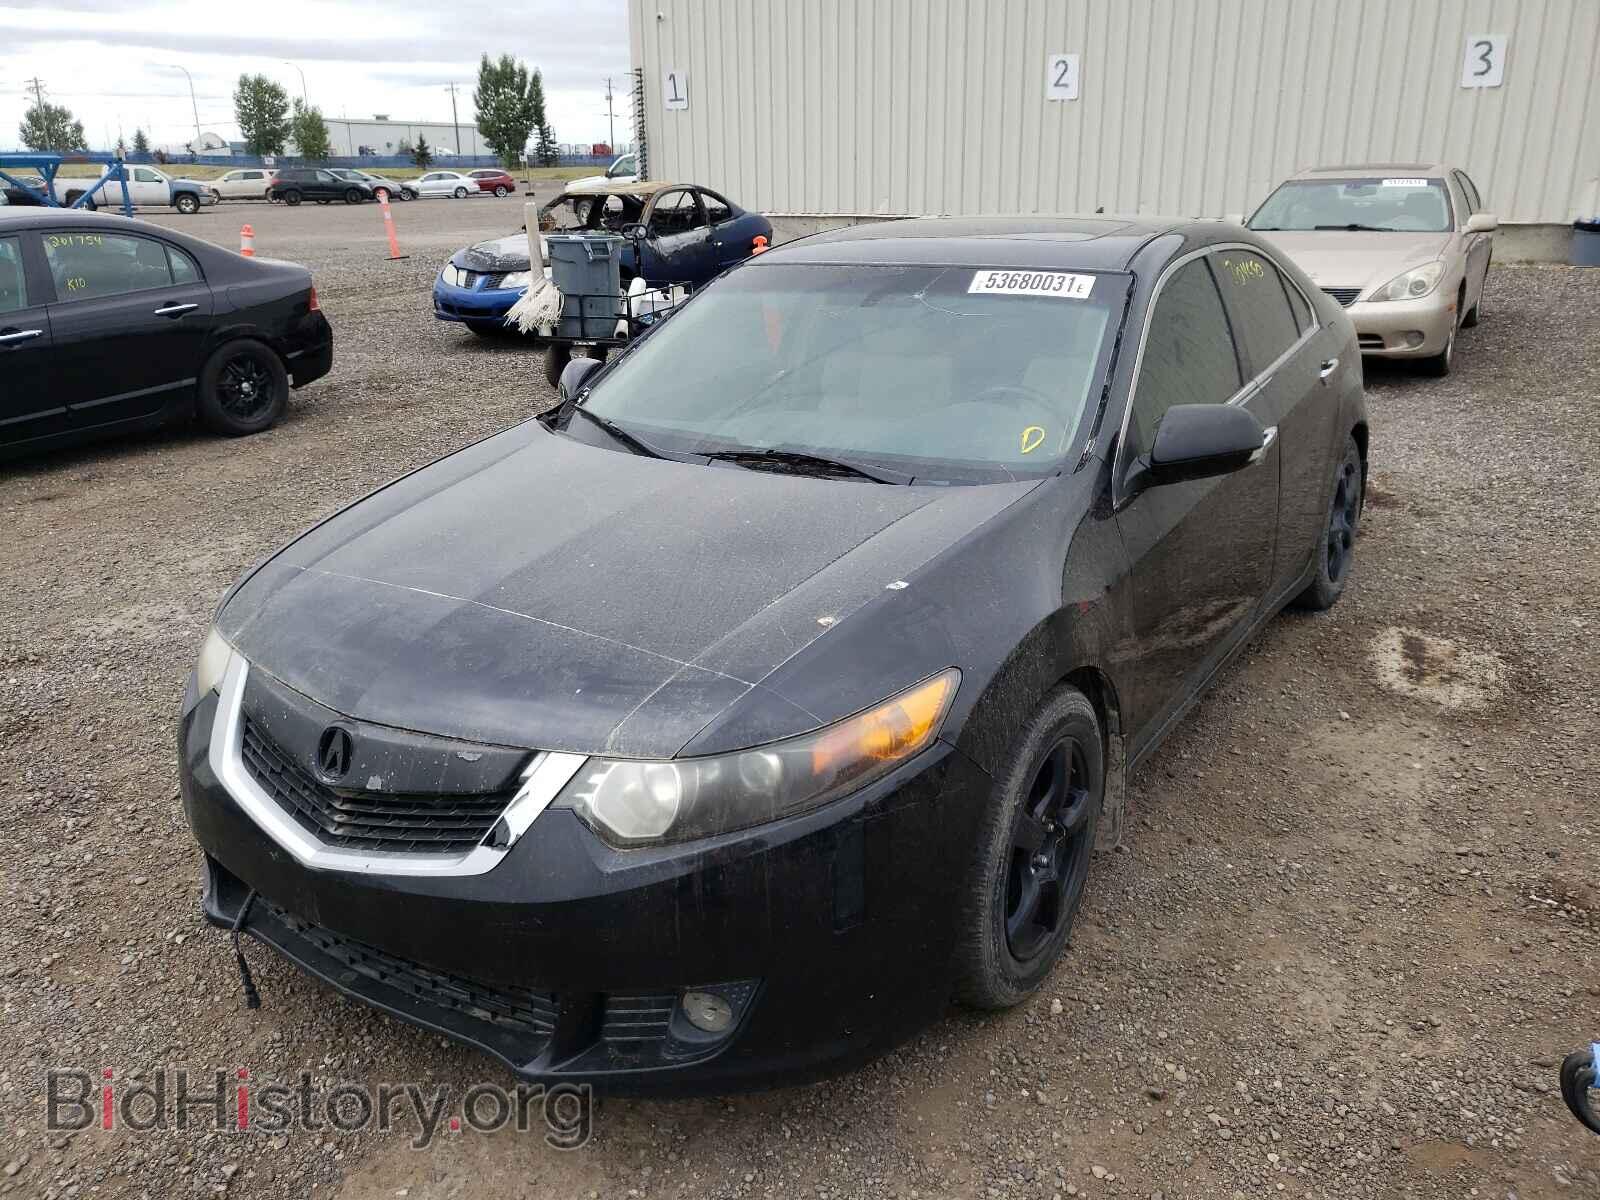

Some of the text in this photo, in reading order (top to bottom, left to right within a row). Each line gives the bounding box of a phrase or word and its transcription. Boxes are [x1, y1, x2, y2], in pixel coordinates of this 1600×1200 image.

[1473, 40, 1493, 76] 3
[668, 73, 685, 102] 1
[1053, 59, 1069, 88] 2
[985, 272, 1076, 293] 53680031
[1021, 426, 1045, 455] D
